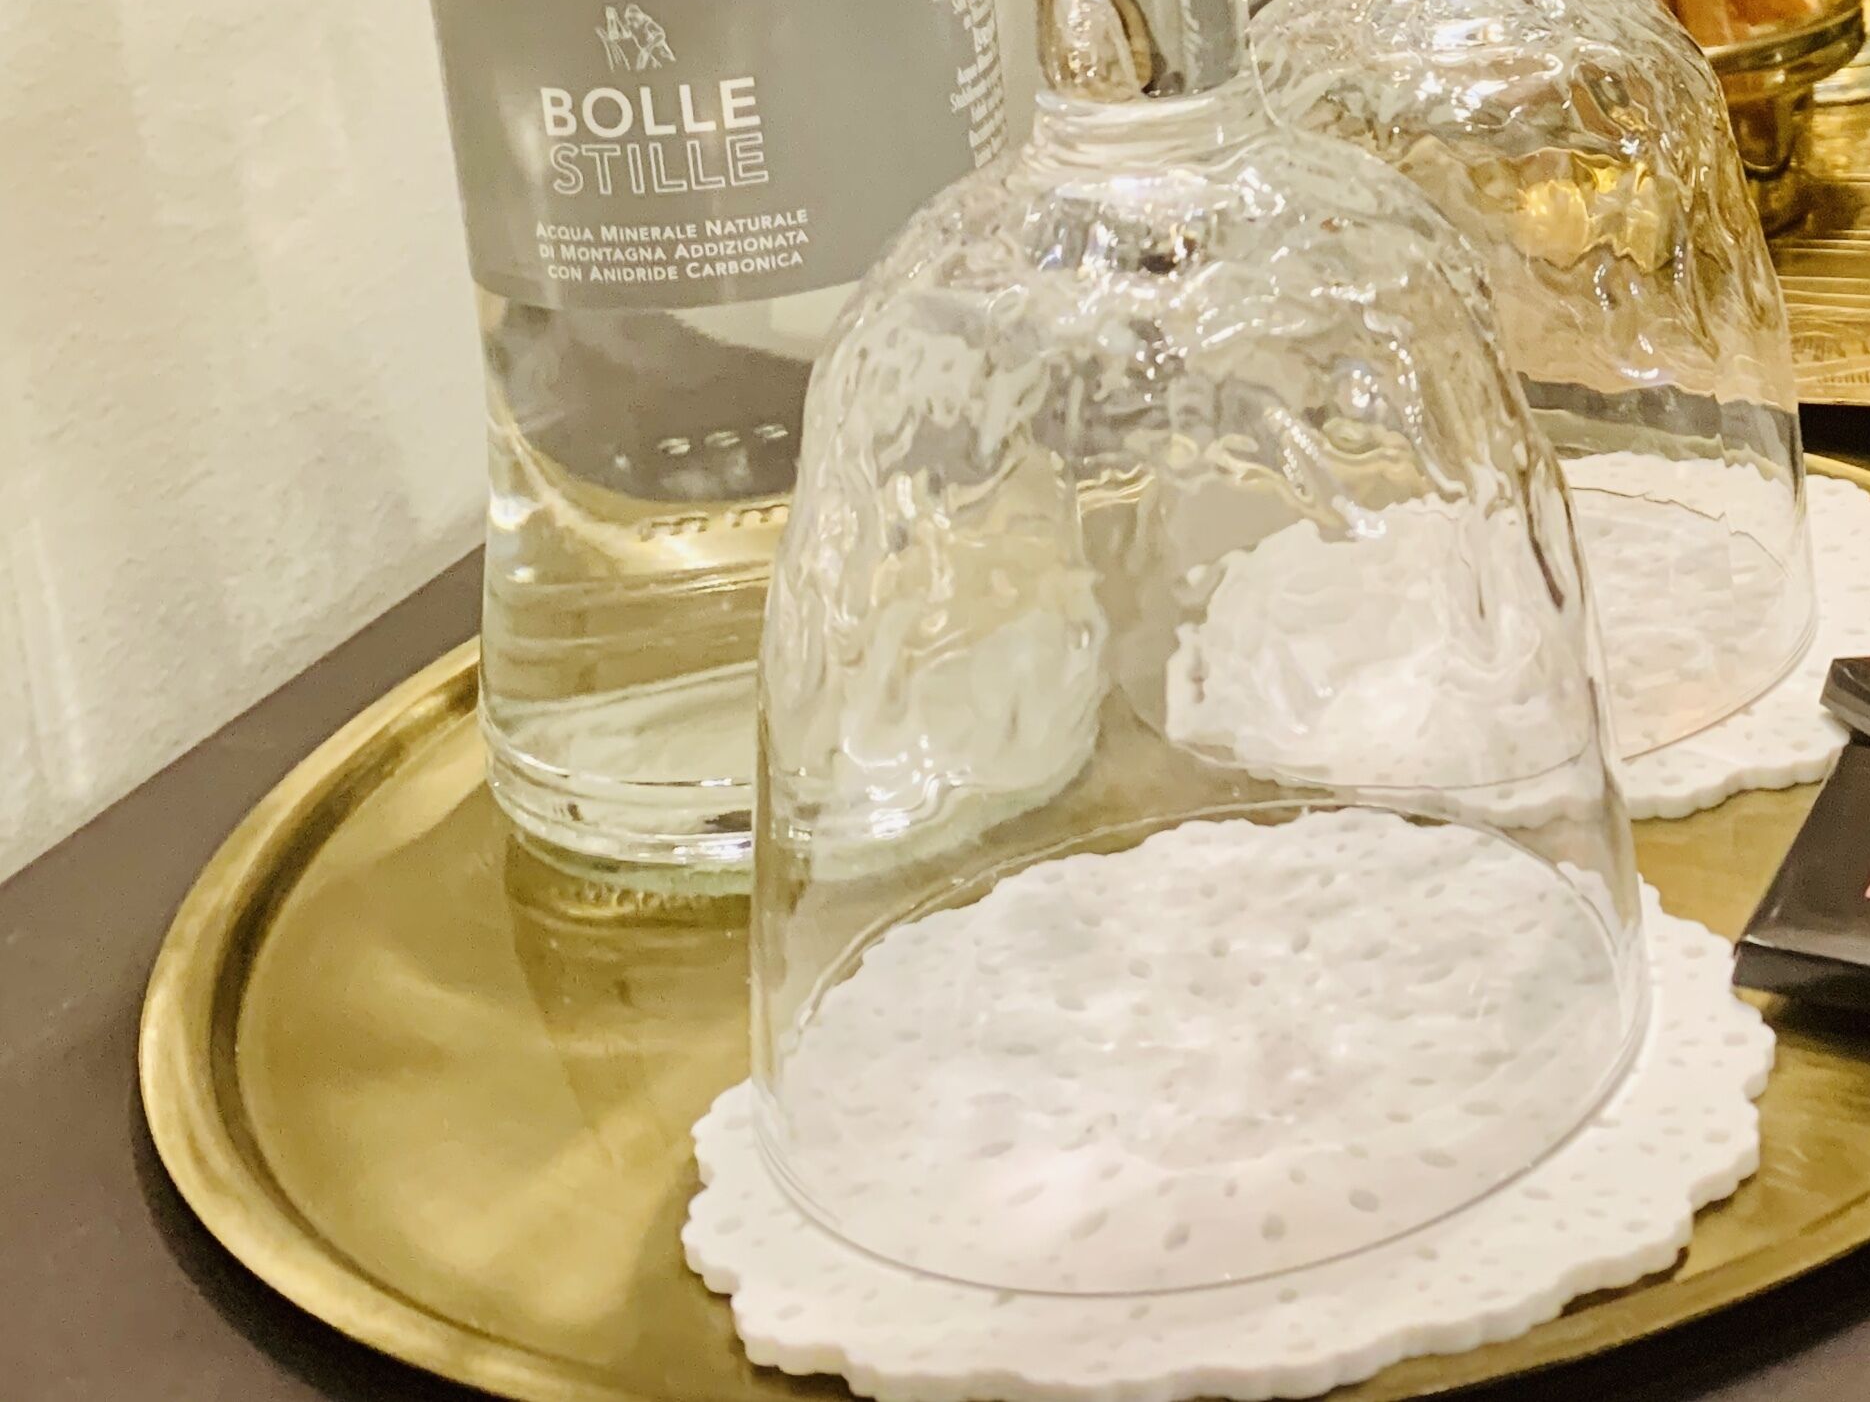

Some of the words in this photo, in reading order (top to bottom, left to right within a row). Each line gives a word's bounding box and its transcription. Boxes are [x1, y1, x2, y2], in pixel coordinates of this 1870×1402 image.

[541, 77, 761, 138] BOLLE
[551, 132, 769, 194] STILLE
[536, 221, 594, 241] ACQUA
[601, 224, 697, 242] MINERALE
[705, 209, 808, 237] NATURALE
[561, 244, 667, 261] MONTAGNA
[674, 230, 809, 259] ADDIZIONATA
[548, 265, 582, 282] CON
[590, 265, 678, 282] ANIDRIDE
[686, 251, 803, 278] CARBONICA
